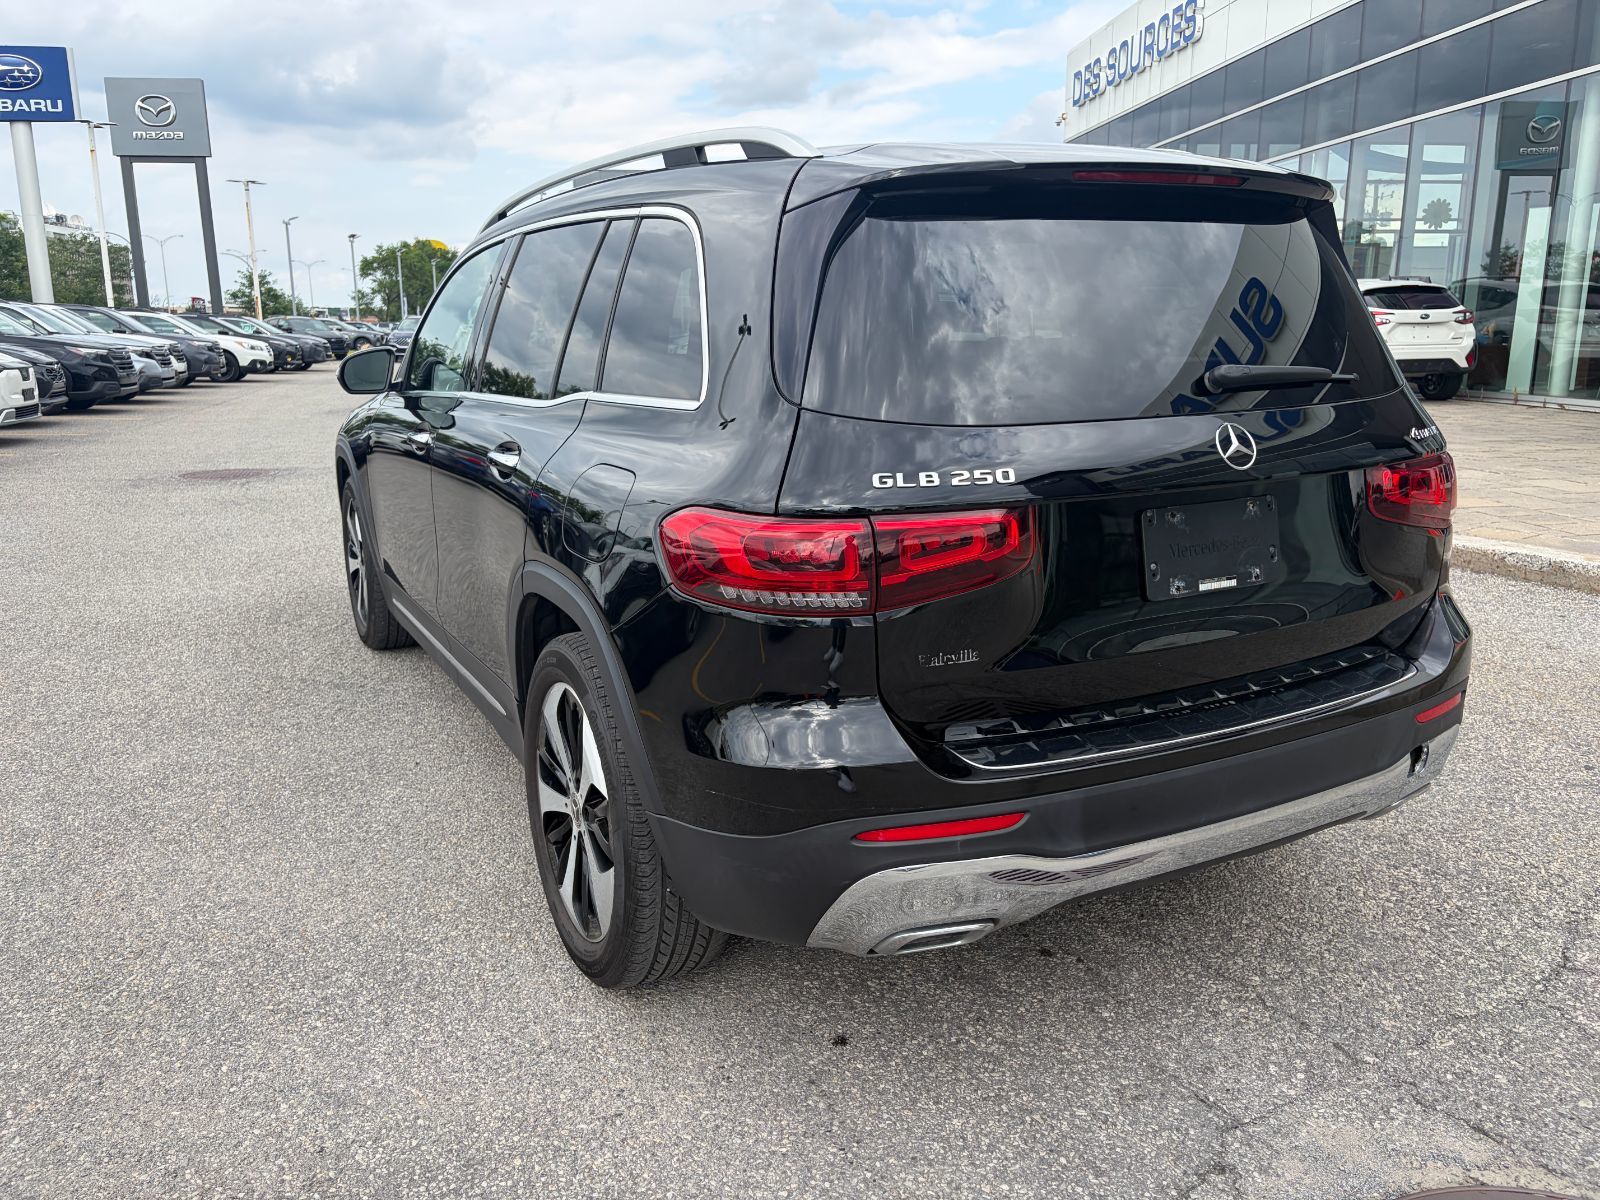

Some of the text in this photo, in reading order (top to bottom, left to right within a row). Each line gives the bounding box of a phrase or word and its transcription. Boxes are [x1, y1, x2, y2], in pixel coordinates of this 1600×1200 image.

[1072, 0, 1204, 108] DES SOURCES
[132, 131, 184, 140] mazda
[871, 467, 1016, 489] GLB 250
[1168, 534, 1260, 559] Mercedes-Be
